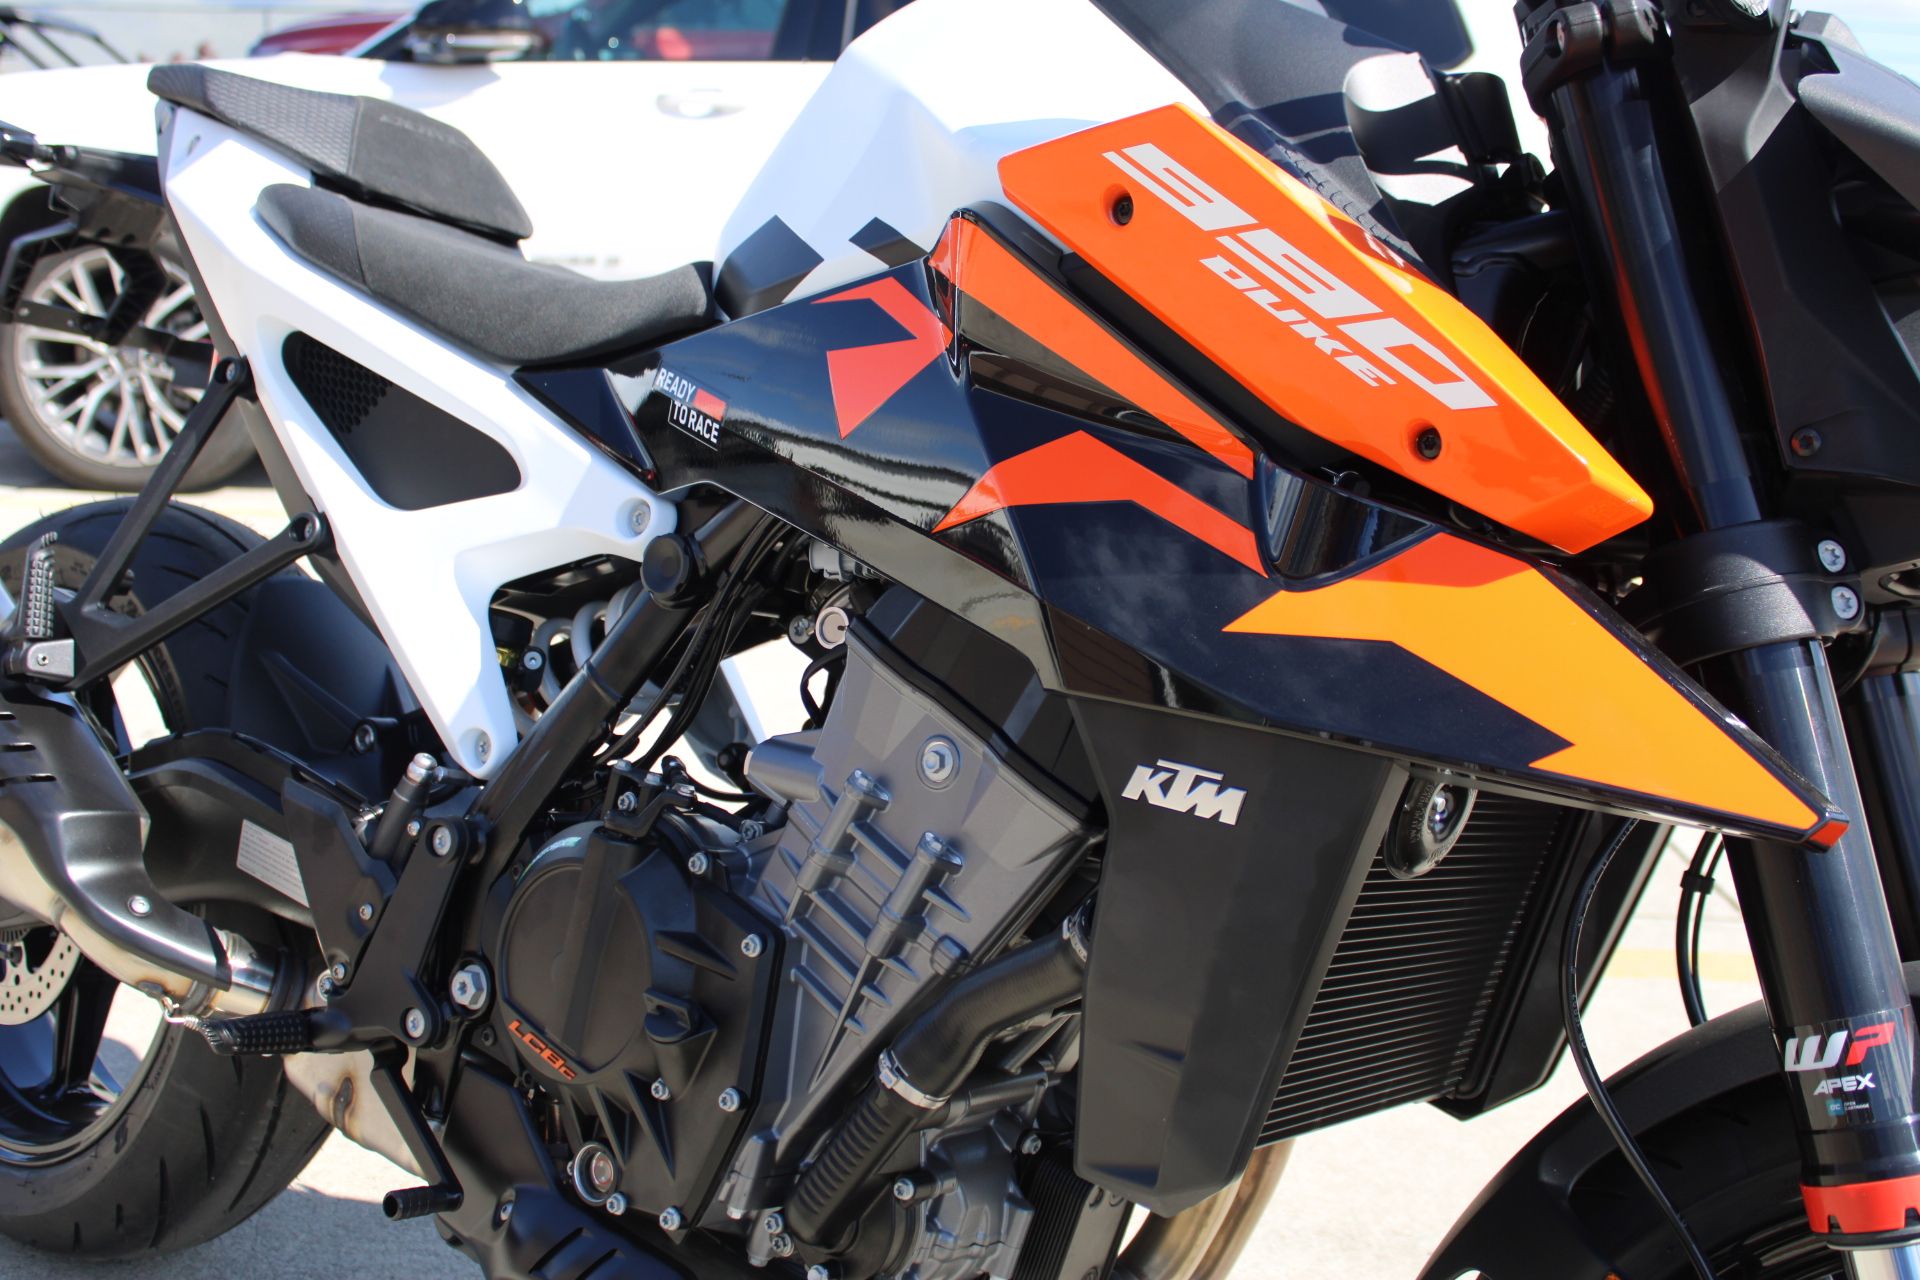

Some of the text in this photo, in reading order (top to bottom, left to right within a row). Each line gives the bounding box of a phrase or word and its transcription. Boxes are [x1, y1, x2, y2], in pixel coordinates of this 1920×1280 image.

[1102, 142, 1498, 411] 990
[1199, 254, 1397, 387] DUKE
[656, 367, 697, 403] READY
[673, 401, 720, 444] TO RACE
[1121, 758, 1248, 826] KTM
[1784, 1021, 1896, 1072] WP
[1813, 1072, 1877, 1096] APEX
